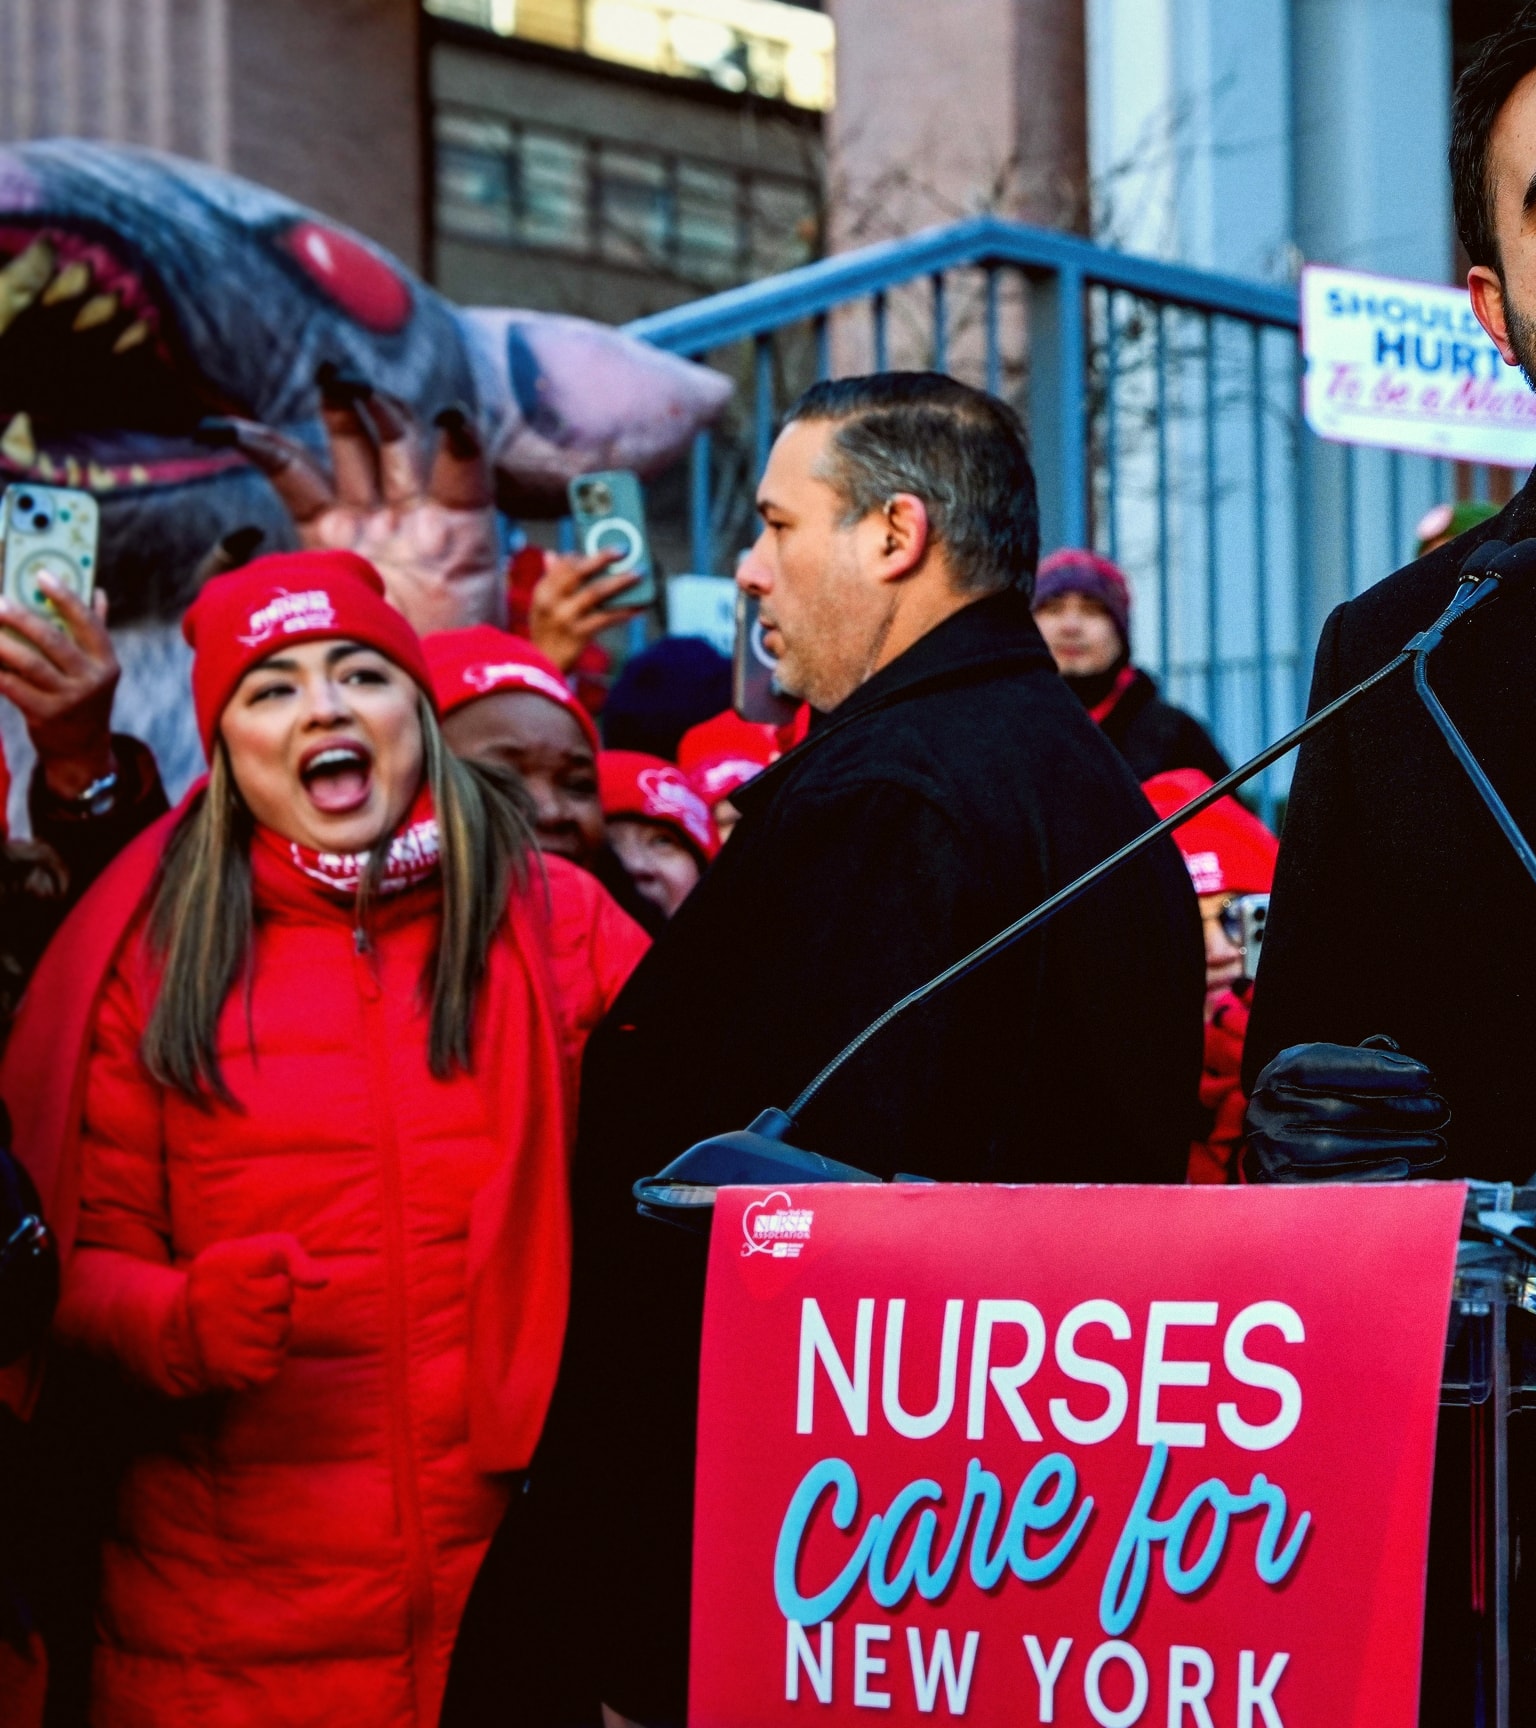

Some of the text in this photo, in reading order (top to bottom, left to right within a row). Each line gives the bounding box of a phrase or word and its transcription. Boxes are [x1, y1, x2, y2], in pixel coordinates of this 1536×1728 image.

[1328, 361, 1358, 397] To
[1376, 372, 1407, 401] be
[1421, 388, 1440, 408] a
[1375, 329, 1501, 380] HURT
[796, 1298, 1305, 1450] NURSES
[774, 1440, 1311, 1635] Care for
[785, 1619, 1290, 1728] NEW YORK
